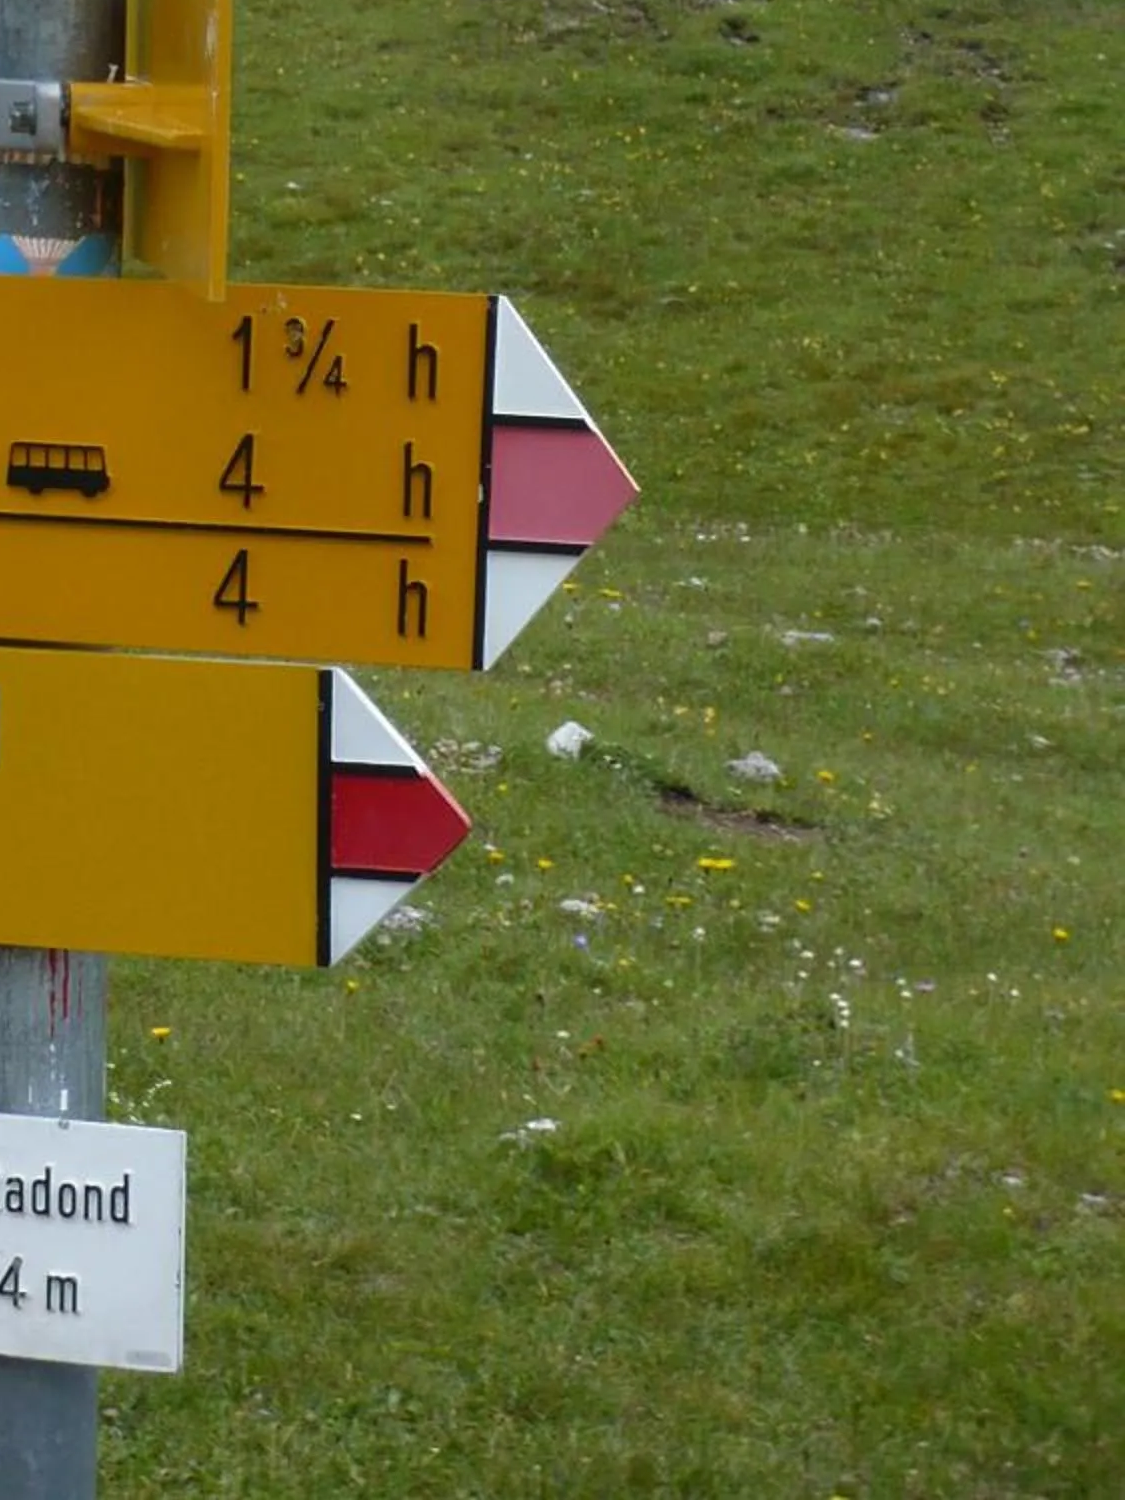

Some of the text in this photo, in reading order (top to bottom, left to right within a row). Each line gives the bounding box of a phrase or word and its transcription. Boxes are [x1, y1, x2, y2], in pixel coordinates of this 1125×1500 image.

[408, 323, 439, 401] h
[219, 433, 265, 510] 4
[403, 441, 434, 519] h
[213, 548, 260, 627] 4
[397, 558, 428, 638] h
[46, 1273, 79, 1315] m
